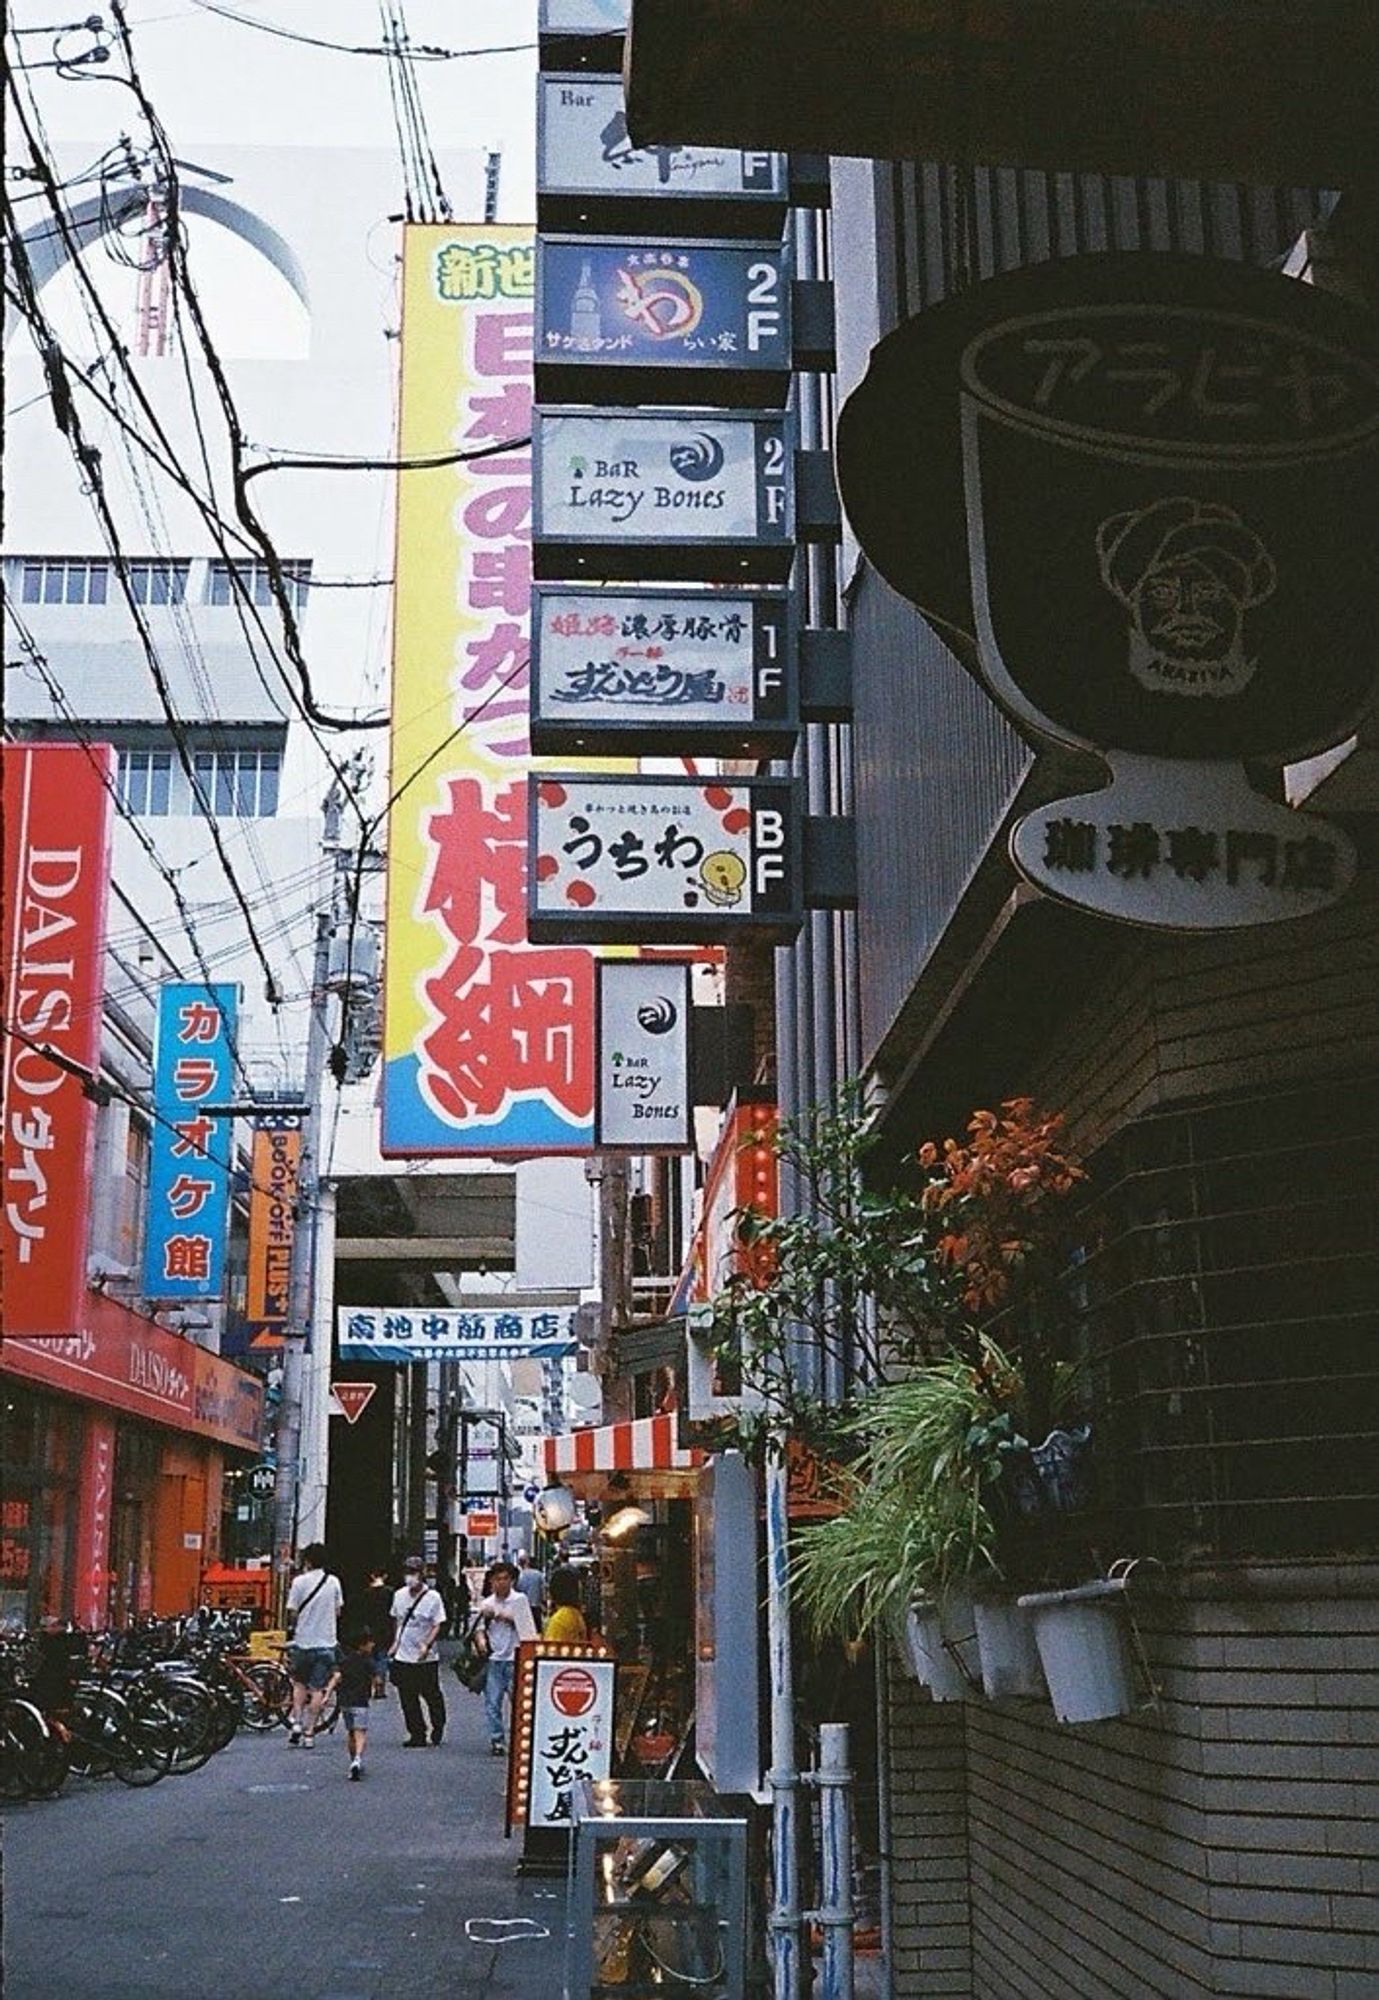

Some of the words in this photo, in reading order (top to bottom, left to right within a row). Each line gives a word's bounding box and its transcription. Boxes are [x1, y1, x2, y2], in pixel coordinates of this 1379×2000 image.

[561, 90, 595, 107] Bar
[744, 151, 769, 177] F
[747, 263, 781, 351] 2F
[569, 486, 645, 522] Lazy
[654, 486, 726, 509] Bones
[763, 438, 785, 524] 2F
[758, 625, 783, 698] 1F
[563, 815, 704, 881] うちわ
[755, 810, 785, 894] BF
[13, 845, 82, 1096] DAISO
[612, 1074, 661, 1099] Lazy
[632, 1104, 680, 1119] Bones
[163, 1001, 220, 1281] カラオケ館
[7, 1106, 55, 1263] ダイソー
